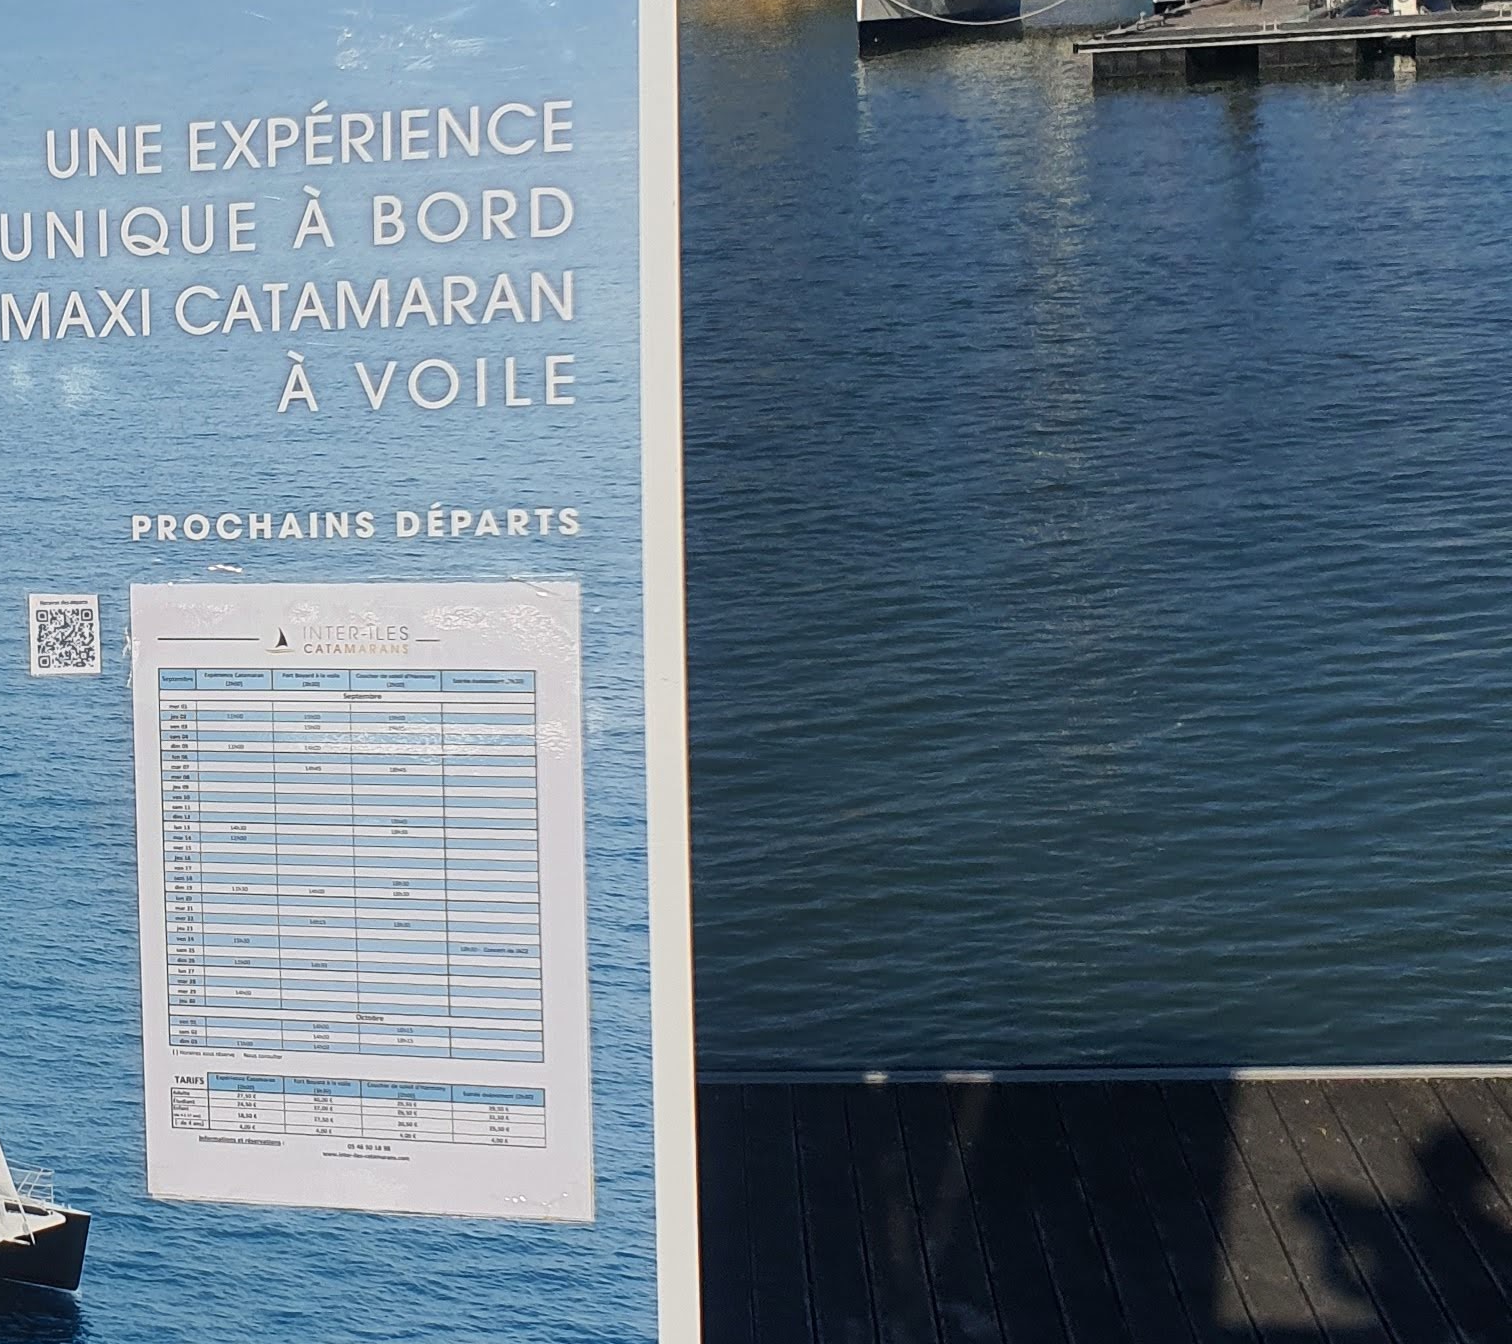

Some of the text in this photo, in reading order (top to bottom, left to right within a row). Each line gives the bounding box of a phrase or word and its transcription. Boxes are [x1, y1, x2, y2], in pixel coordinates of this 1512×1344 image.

[46, 99, 575, 180] UNE EXPÉRIENCE
[0, 185, 575, 262] UNIQUE À BORD
[0, 286, 151, 342] MAXI
[174, 269, 575, 336] CATAMARAN
[277, 349, 577, 414] À VOILE
[130, 502, 581, 542] PROCHAINS DÉPARTS
[303, 623, 409, 641] INTER-ÎLES
[303, 643, 409, 655] CATAMARANS
[343, 693, 382, 701] Septembre
[356, 1014, 384, 1022] Octobre
[174, 1075, 205, 1085] TARIFS
